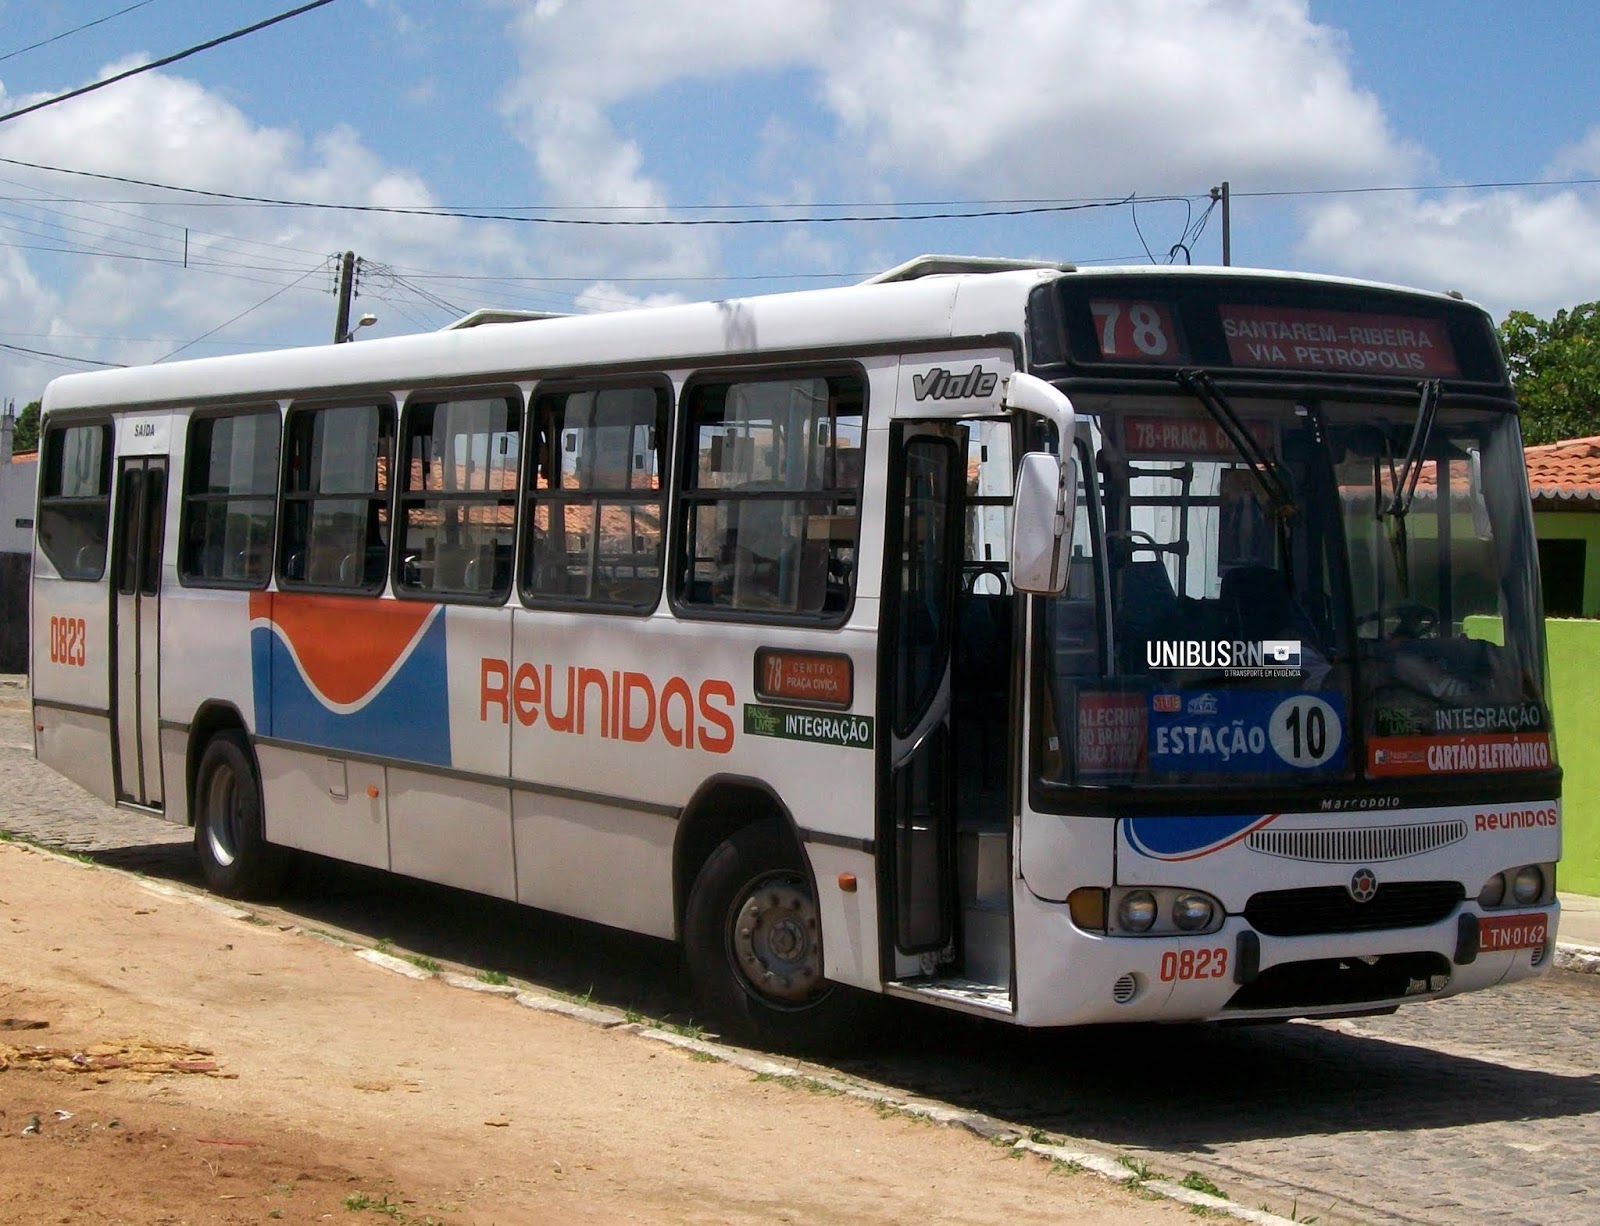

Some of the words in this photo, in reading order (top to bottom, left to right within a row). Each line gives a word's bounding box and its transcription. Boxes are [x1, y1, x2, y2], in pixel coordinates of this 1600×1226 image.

[1090, 303, 1168, 356] 78
[1247, 343, 1286, 363] VIA
[913, 365, 998, 401] Viale
[134, 421, 155, 437] SAÍDA
[51, 616, 85, 667] 0823
[768, 656, 782, 691] 78
[793, 662, 833, 675] CENTRO
[748, 706, 770, 719] PASSE
[755, 718, 775, 732] LIVRE
[1435, 703, 1540, 731] INTEGRAÇÃO
[785, 714, 869, 745] INTEGRAÇÃO
[1157, 720, 1265, 761] ESTAÇÃO
[1286, 706, 1326, 759] 10
[1428, 738, 1476, 771] CARTÃO
[1479, 736, 1548, 769] ELETRÔNICO
[1321, 797, 1400, 811] Marcopolo
[1160, 948, 1228, 982] 0823
